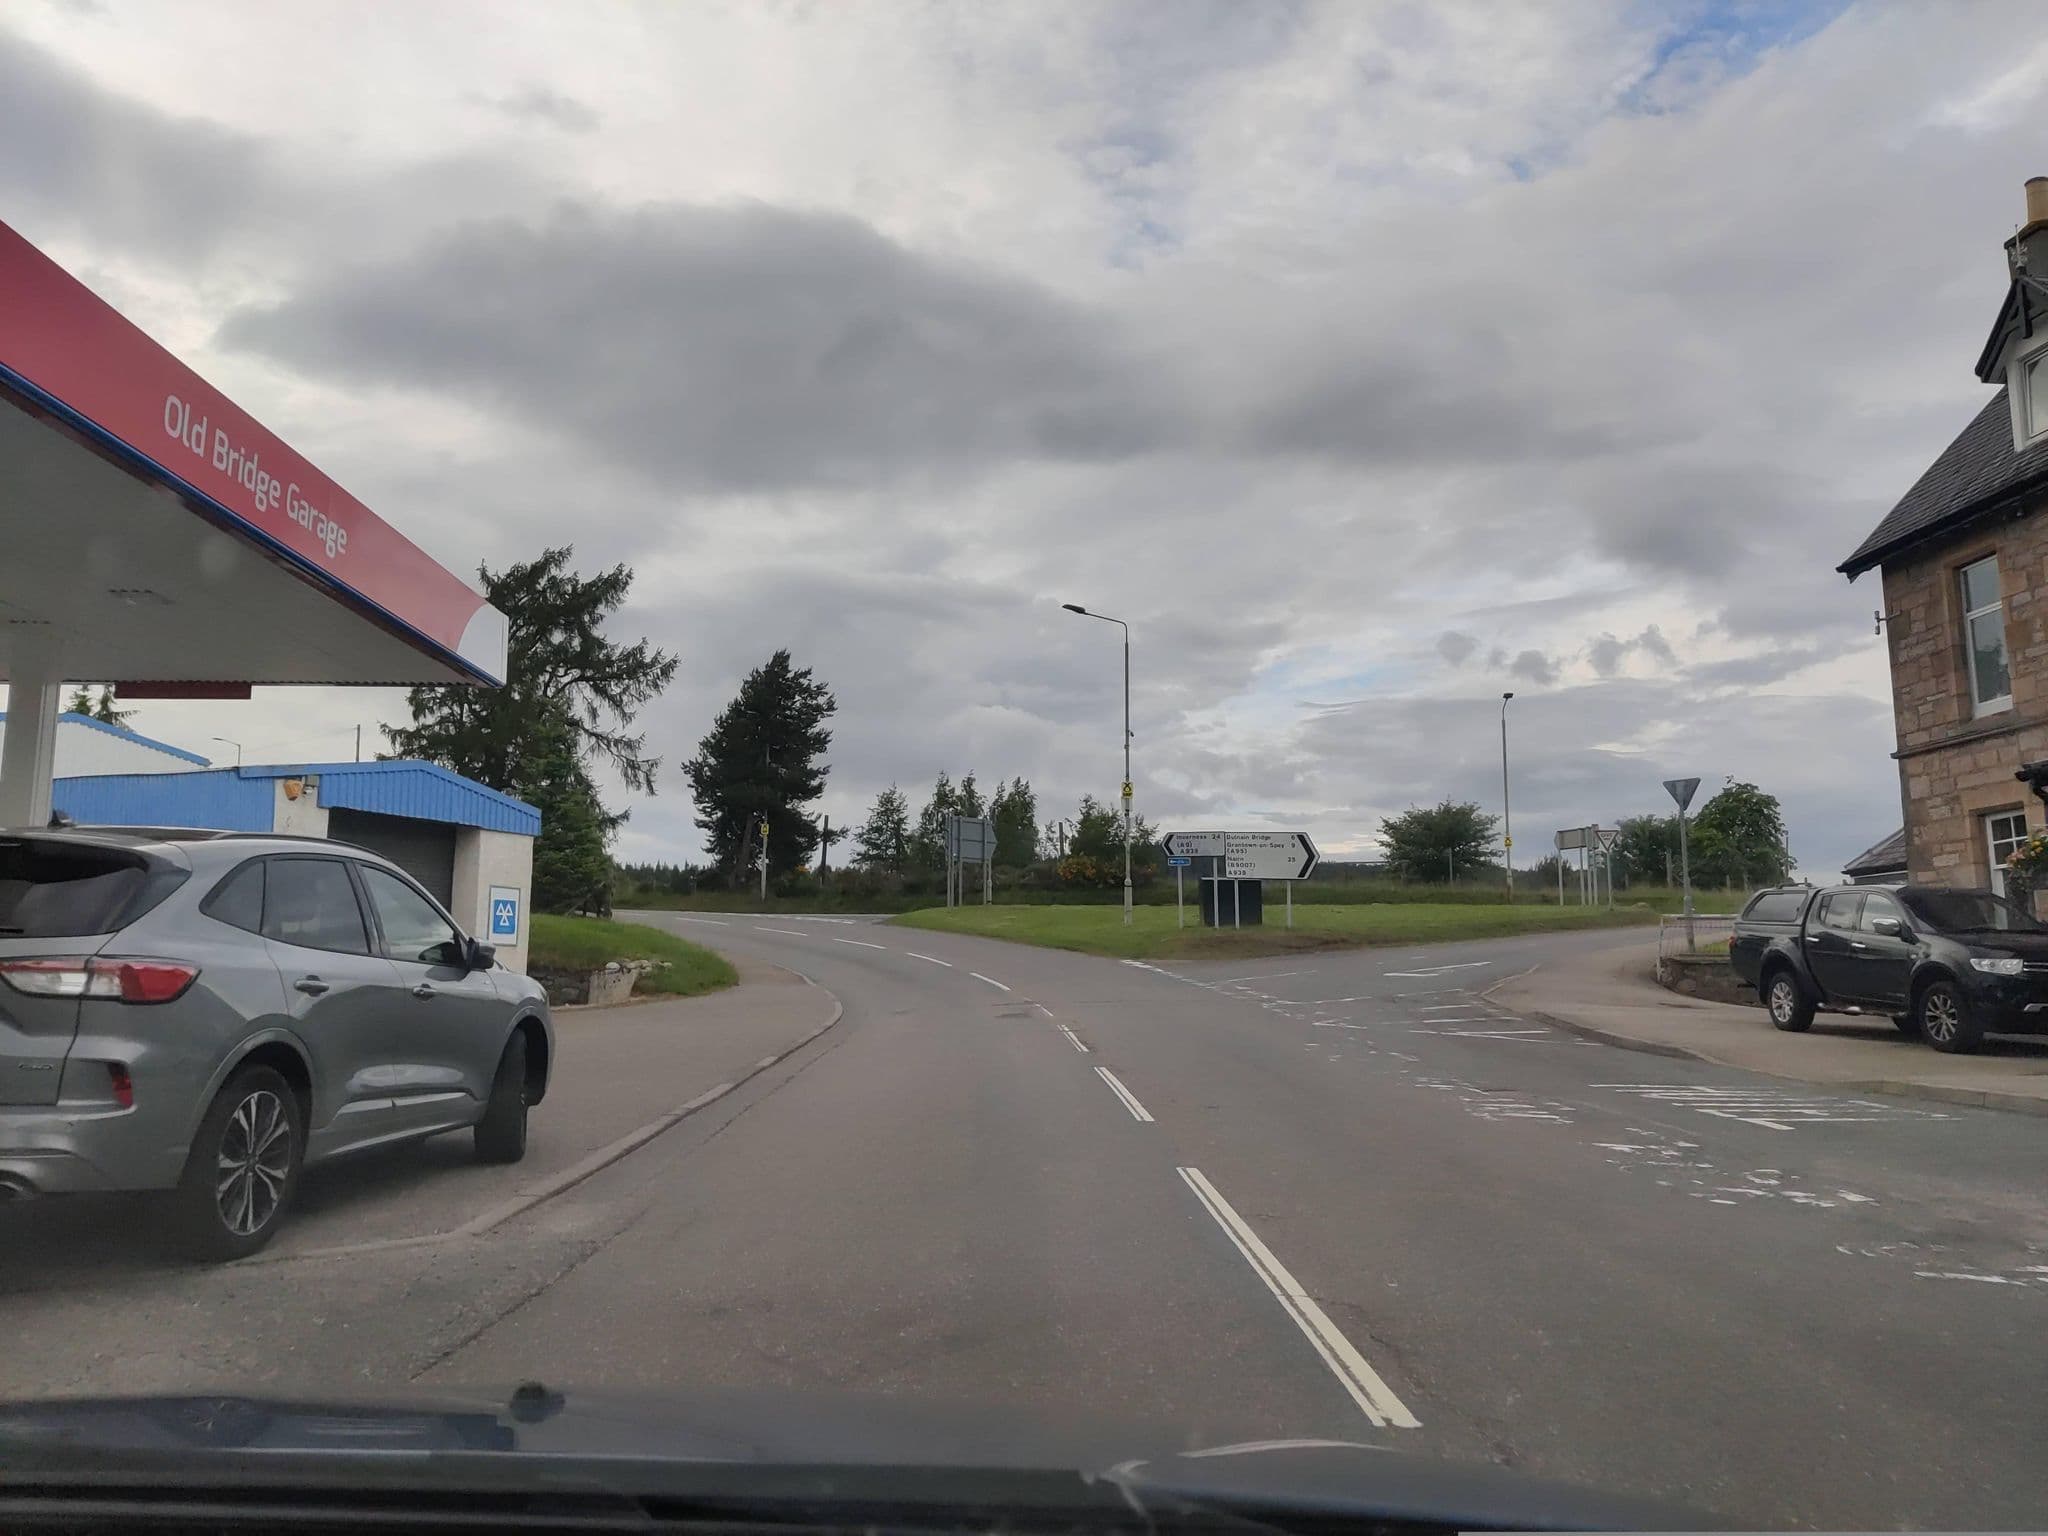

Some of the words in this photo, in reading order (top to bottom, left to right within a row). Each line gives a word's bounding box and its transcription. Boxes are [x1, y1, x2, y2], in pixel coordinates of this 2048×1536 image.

[164, 394, 207, 458] Old
[212, 428, 281, 512] Bridge
[286, 483, 348, 558] Garage
